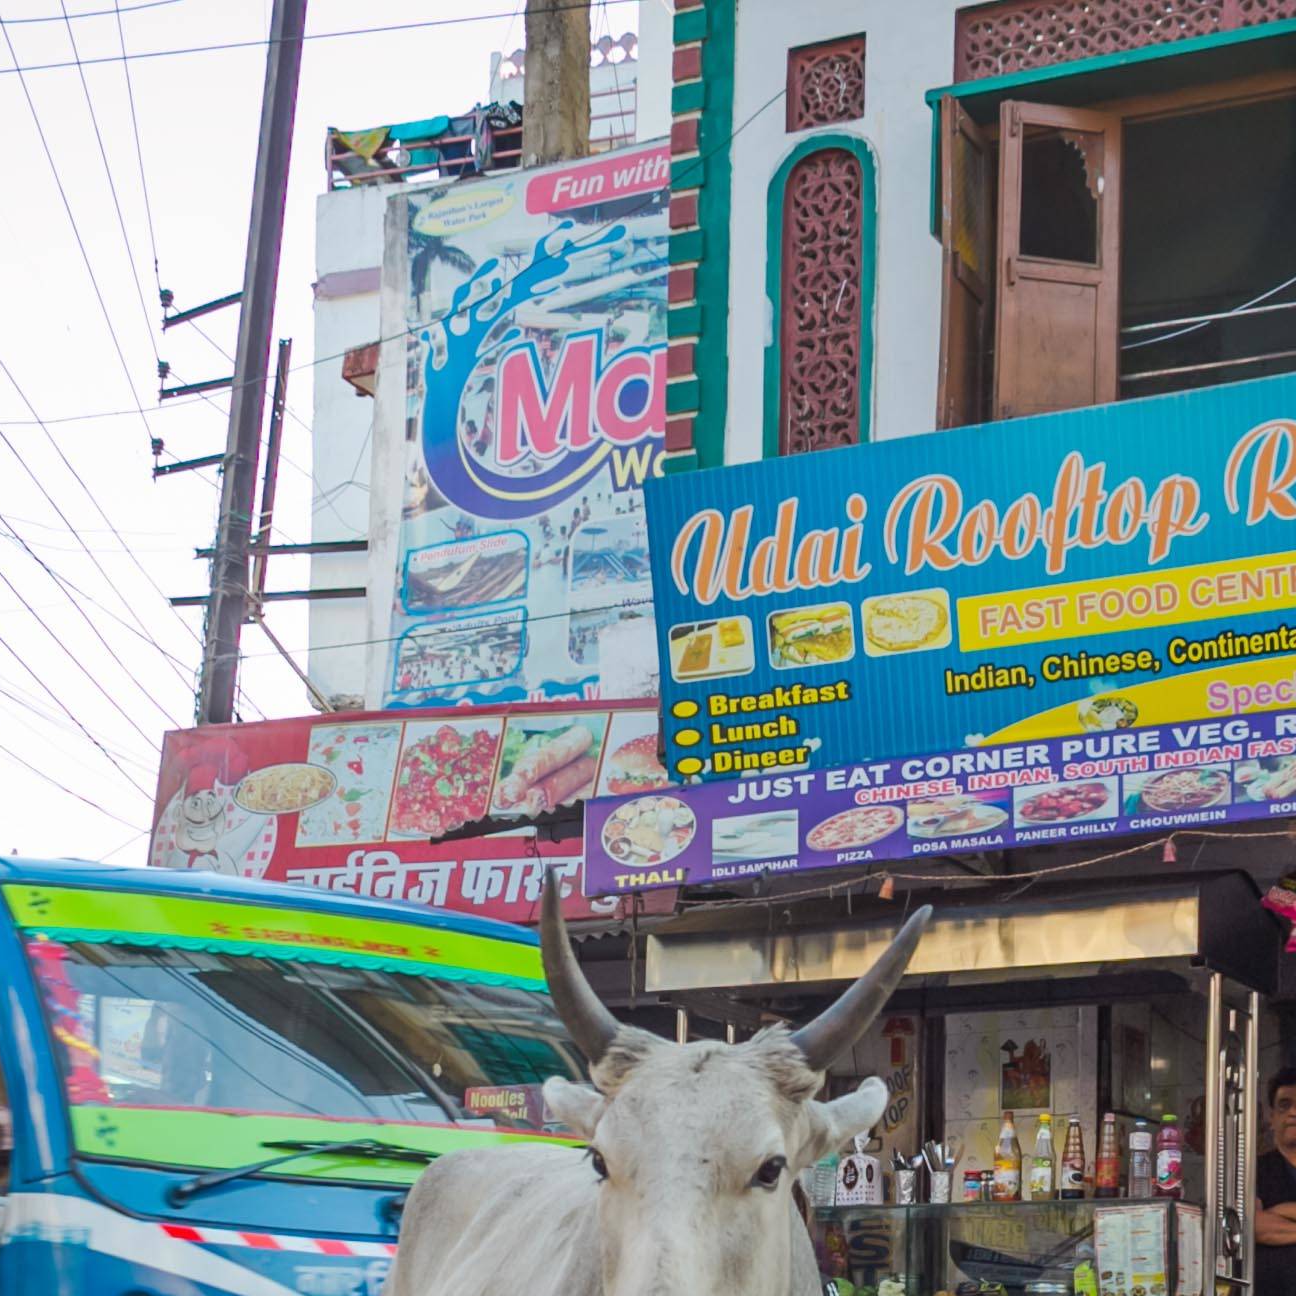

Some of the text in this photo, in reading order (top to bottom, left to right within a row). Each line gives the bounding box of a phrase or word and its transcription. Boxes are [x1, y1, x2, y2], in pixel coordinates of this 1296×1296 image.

[552, 155, 670, 203] Fun with
[496, 333, 666, 462] Ma
[672, 495, 871, 604] Udai
[884, 451, 1210, 575] Rooftop
[978, 598, 1066, 638] FAST
[1077, 580, 1179, 627] FOOD
[946, 661, 1036, 695] Indian,
[1041, 649, 1160, 683] Chinese,
[708, 680, 849, 717] Breakfast
[709, 716, 797, 746] Lunch
[712, 746, 810, 774] Dineer
[728, 773, 815, 805] JUST
[825, 763, 892, 791] EAT
[901, 744, 1050, 781] CORNER
[1061, 730, 1161, 762] PURE
[1171, 721, 1262, 749] VEG.
[855, 778, 963, 805] CHINESE,
[968, 767, 1058, 790] INDIAN,
[1063, 755, 1147, 779] SOUTH
[1155, 743, 1242, 769] INDIAN
[1015, 822, 1118, 842] PANEER CHILLY
[1129, 810, 1227, 830] CHOUWMEIN
[836, 850, 873, 863] PIZZA
[913, 835, 1004, 854] DOSA MASALA
[614, 868, 685, 888] THALI
[712, 864, 736, 877] IDLI
[470, 1090, 525, 1108] Noodles
